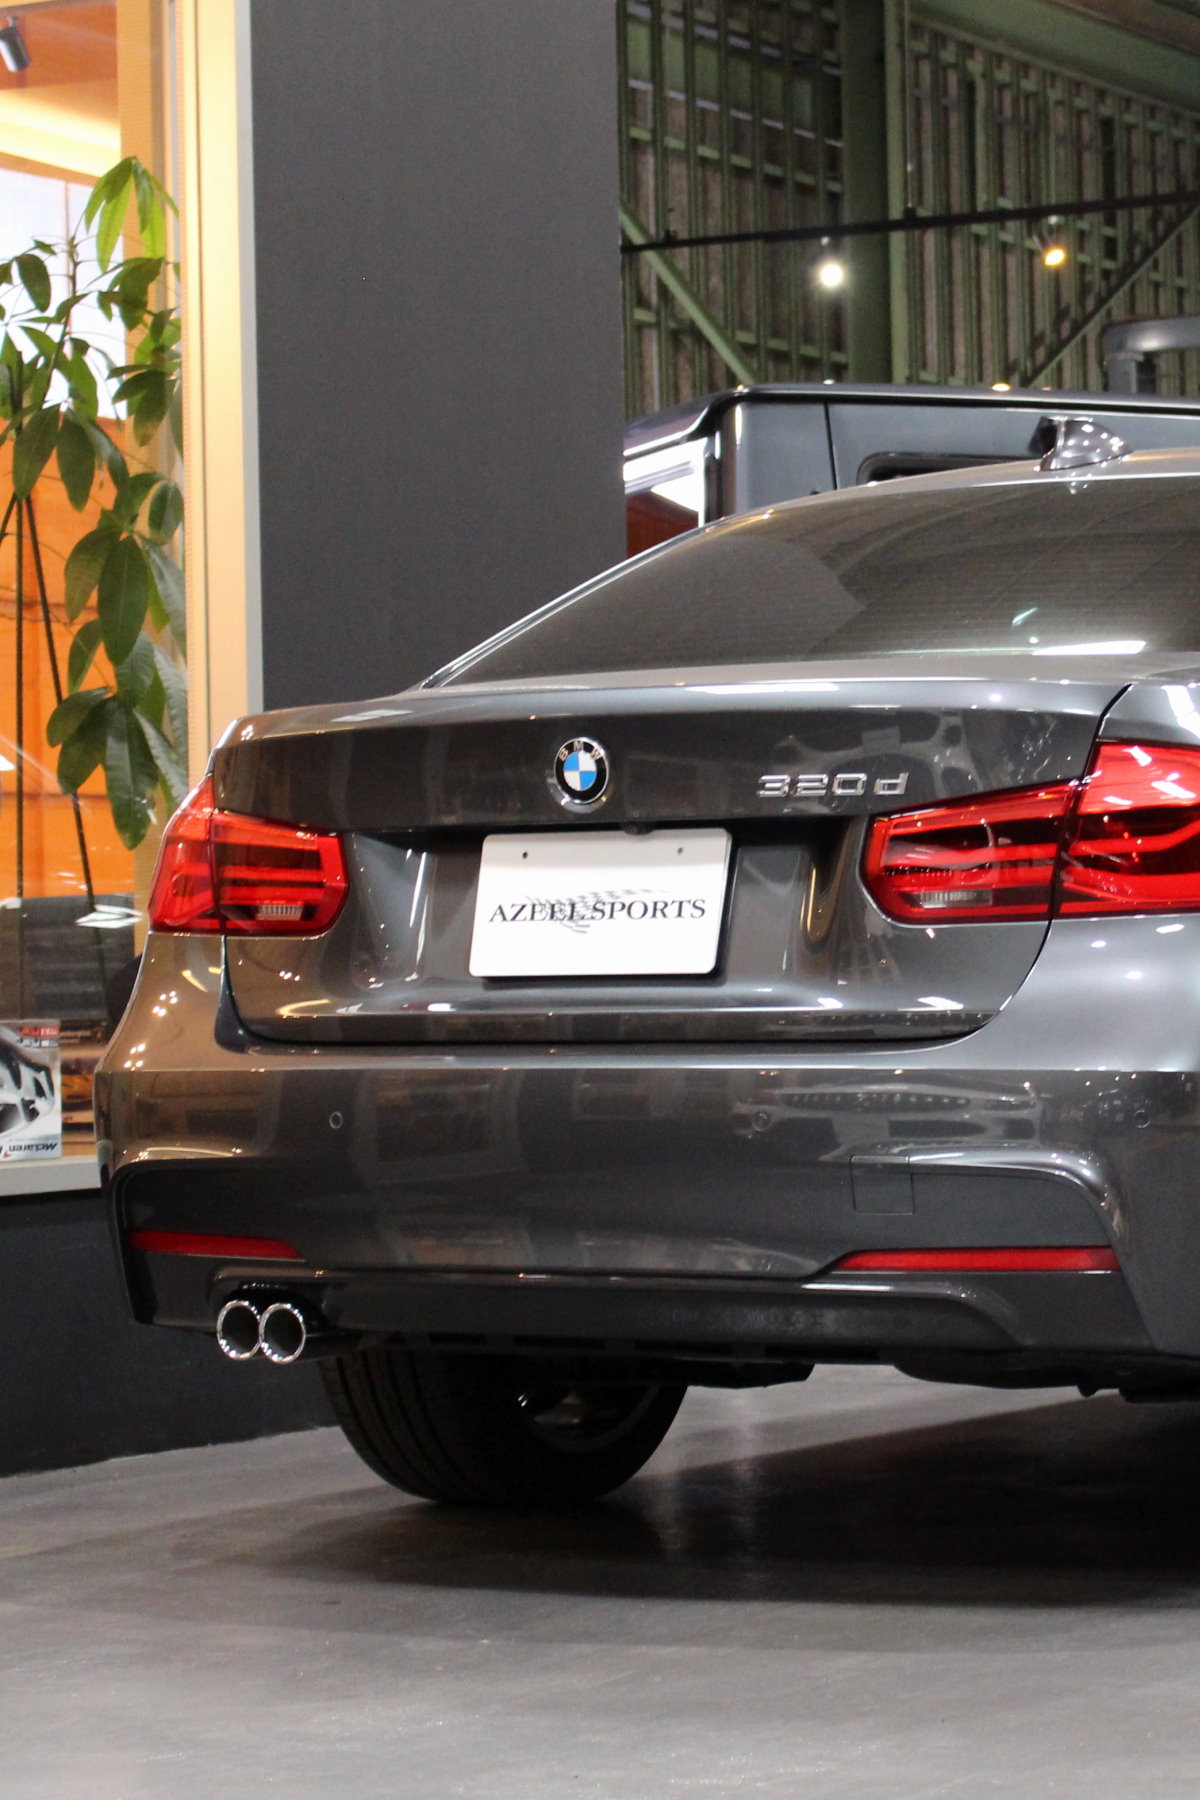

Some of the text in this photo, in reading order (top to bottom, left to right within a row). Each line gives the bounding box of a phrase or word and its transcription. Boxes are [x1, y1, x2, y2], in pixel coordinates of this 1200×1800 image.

[559, 740, 602, 762] BMW
[758, 772, 909, 798] 320d
[589, 898, 707, 921] SPORTS
